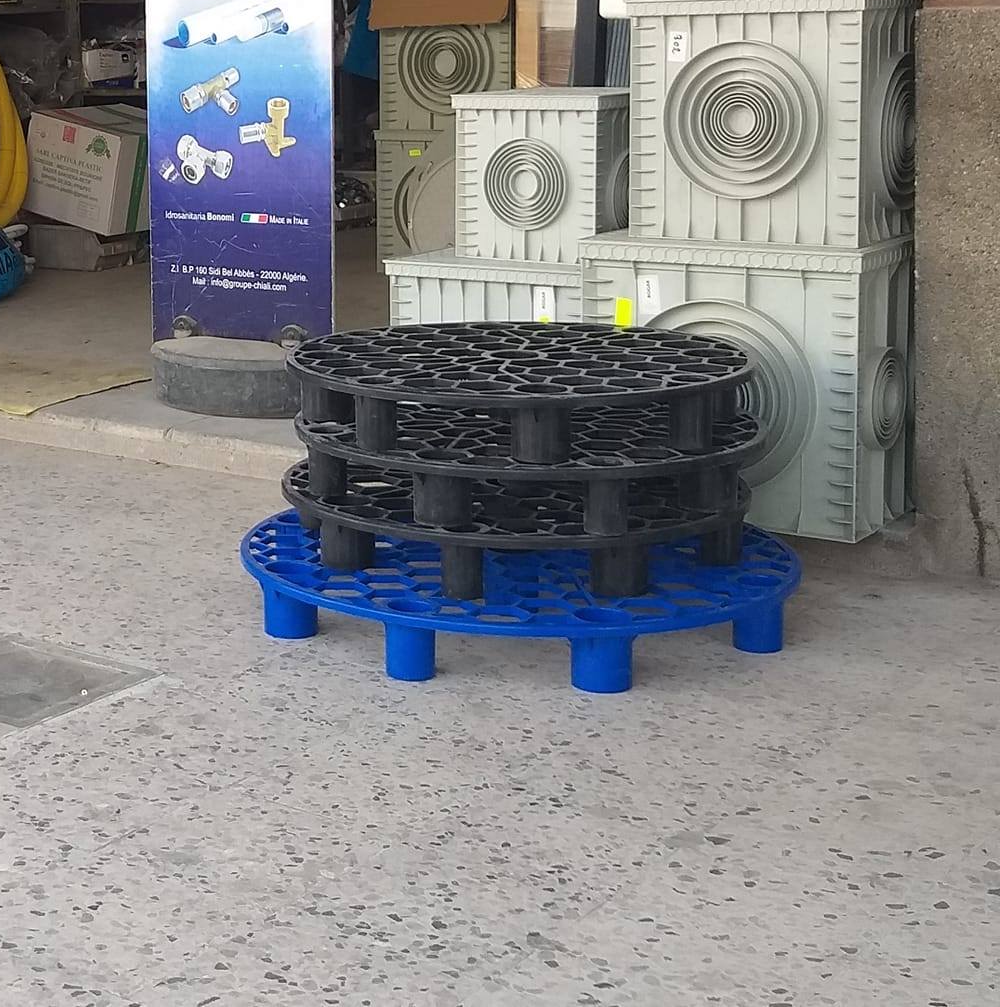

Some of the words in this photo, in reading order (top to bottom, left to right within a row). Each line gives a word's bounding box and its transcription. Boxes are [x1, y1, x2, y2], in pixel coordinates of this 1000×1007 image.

[165, 210, 206, 221] Idrosanitaria
[207, 212, 235, 222] Bonomi
[182, 265, 194, 274] B.P
[208, 266, 221, 276] Sidi
[222, 267, 233, 276] Bel
[260, 270, 281, 280] 22000
[211, 277, 287, 292] info@groupe-chiali.com
